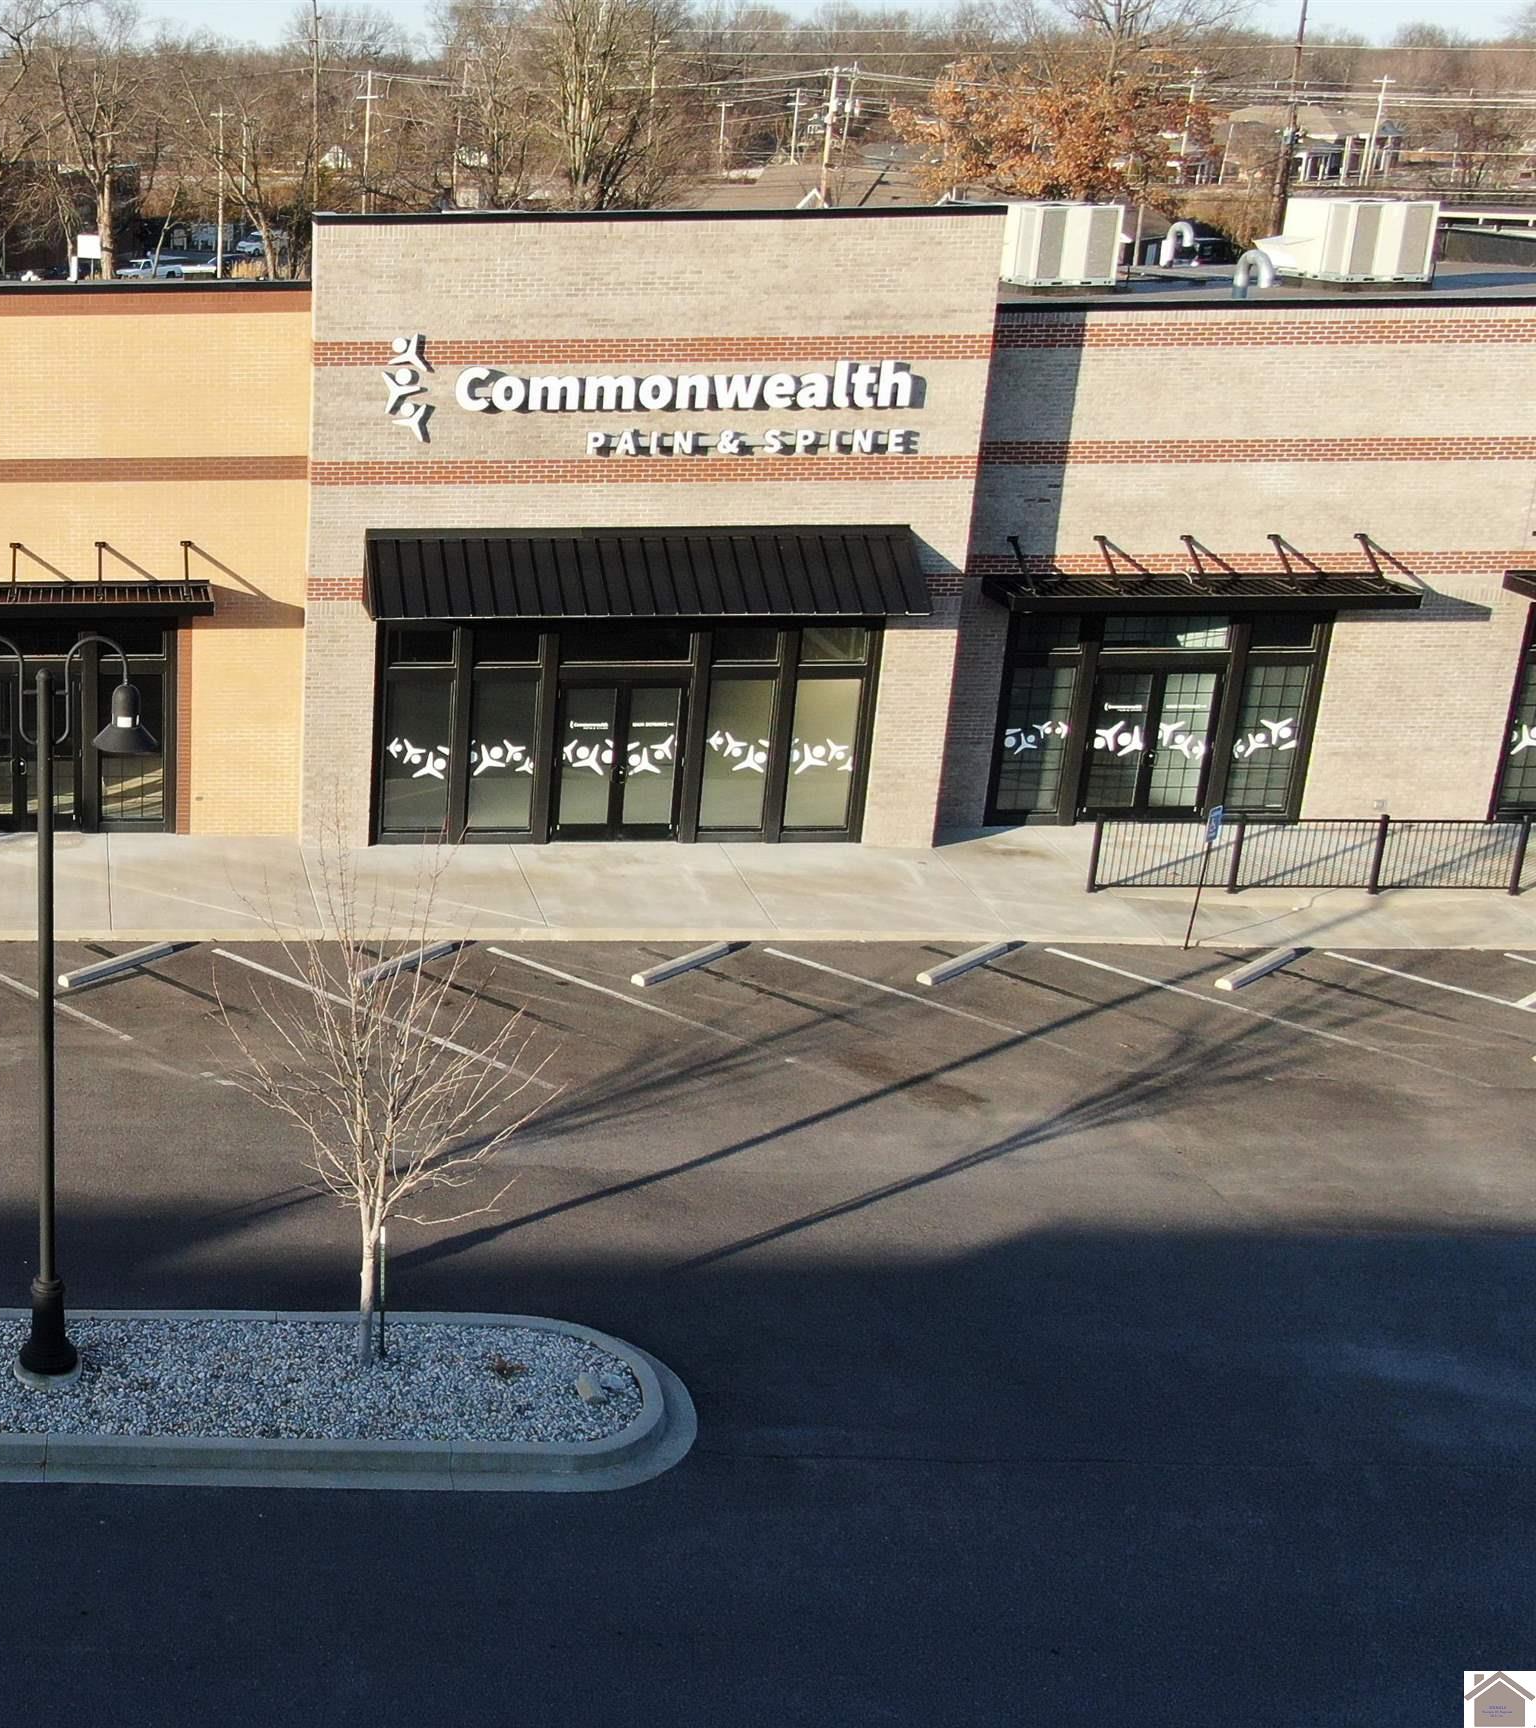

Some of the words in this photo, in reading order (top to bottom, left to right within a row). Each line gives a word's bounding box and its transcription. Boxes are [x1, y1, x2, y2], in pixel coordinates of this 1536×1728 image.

[454, 360, 912, 412] Commonwealth
[586, 431, 693, 455] PAIN
[716, 430, 740, 454] &
[764, 428, 906, 453] SPINE
